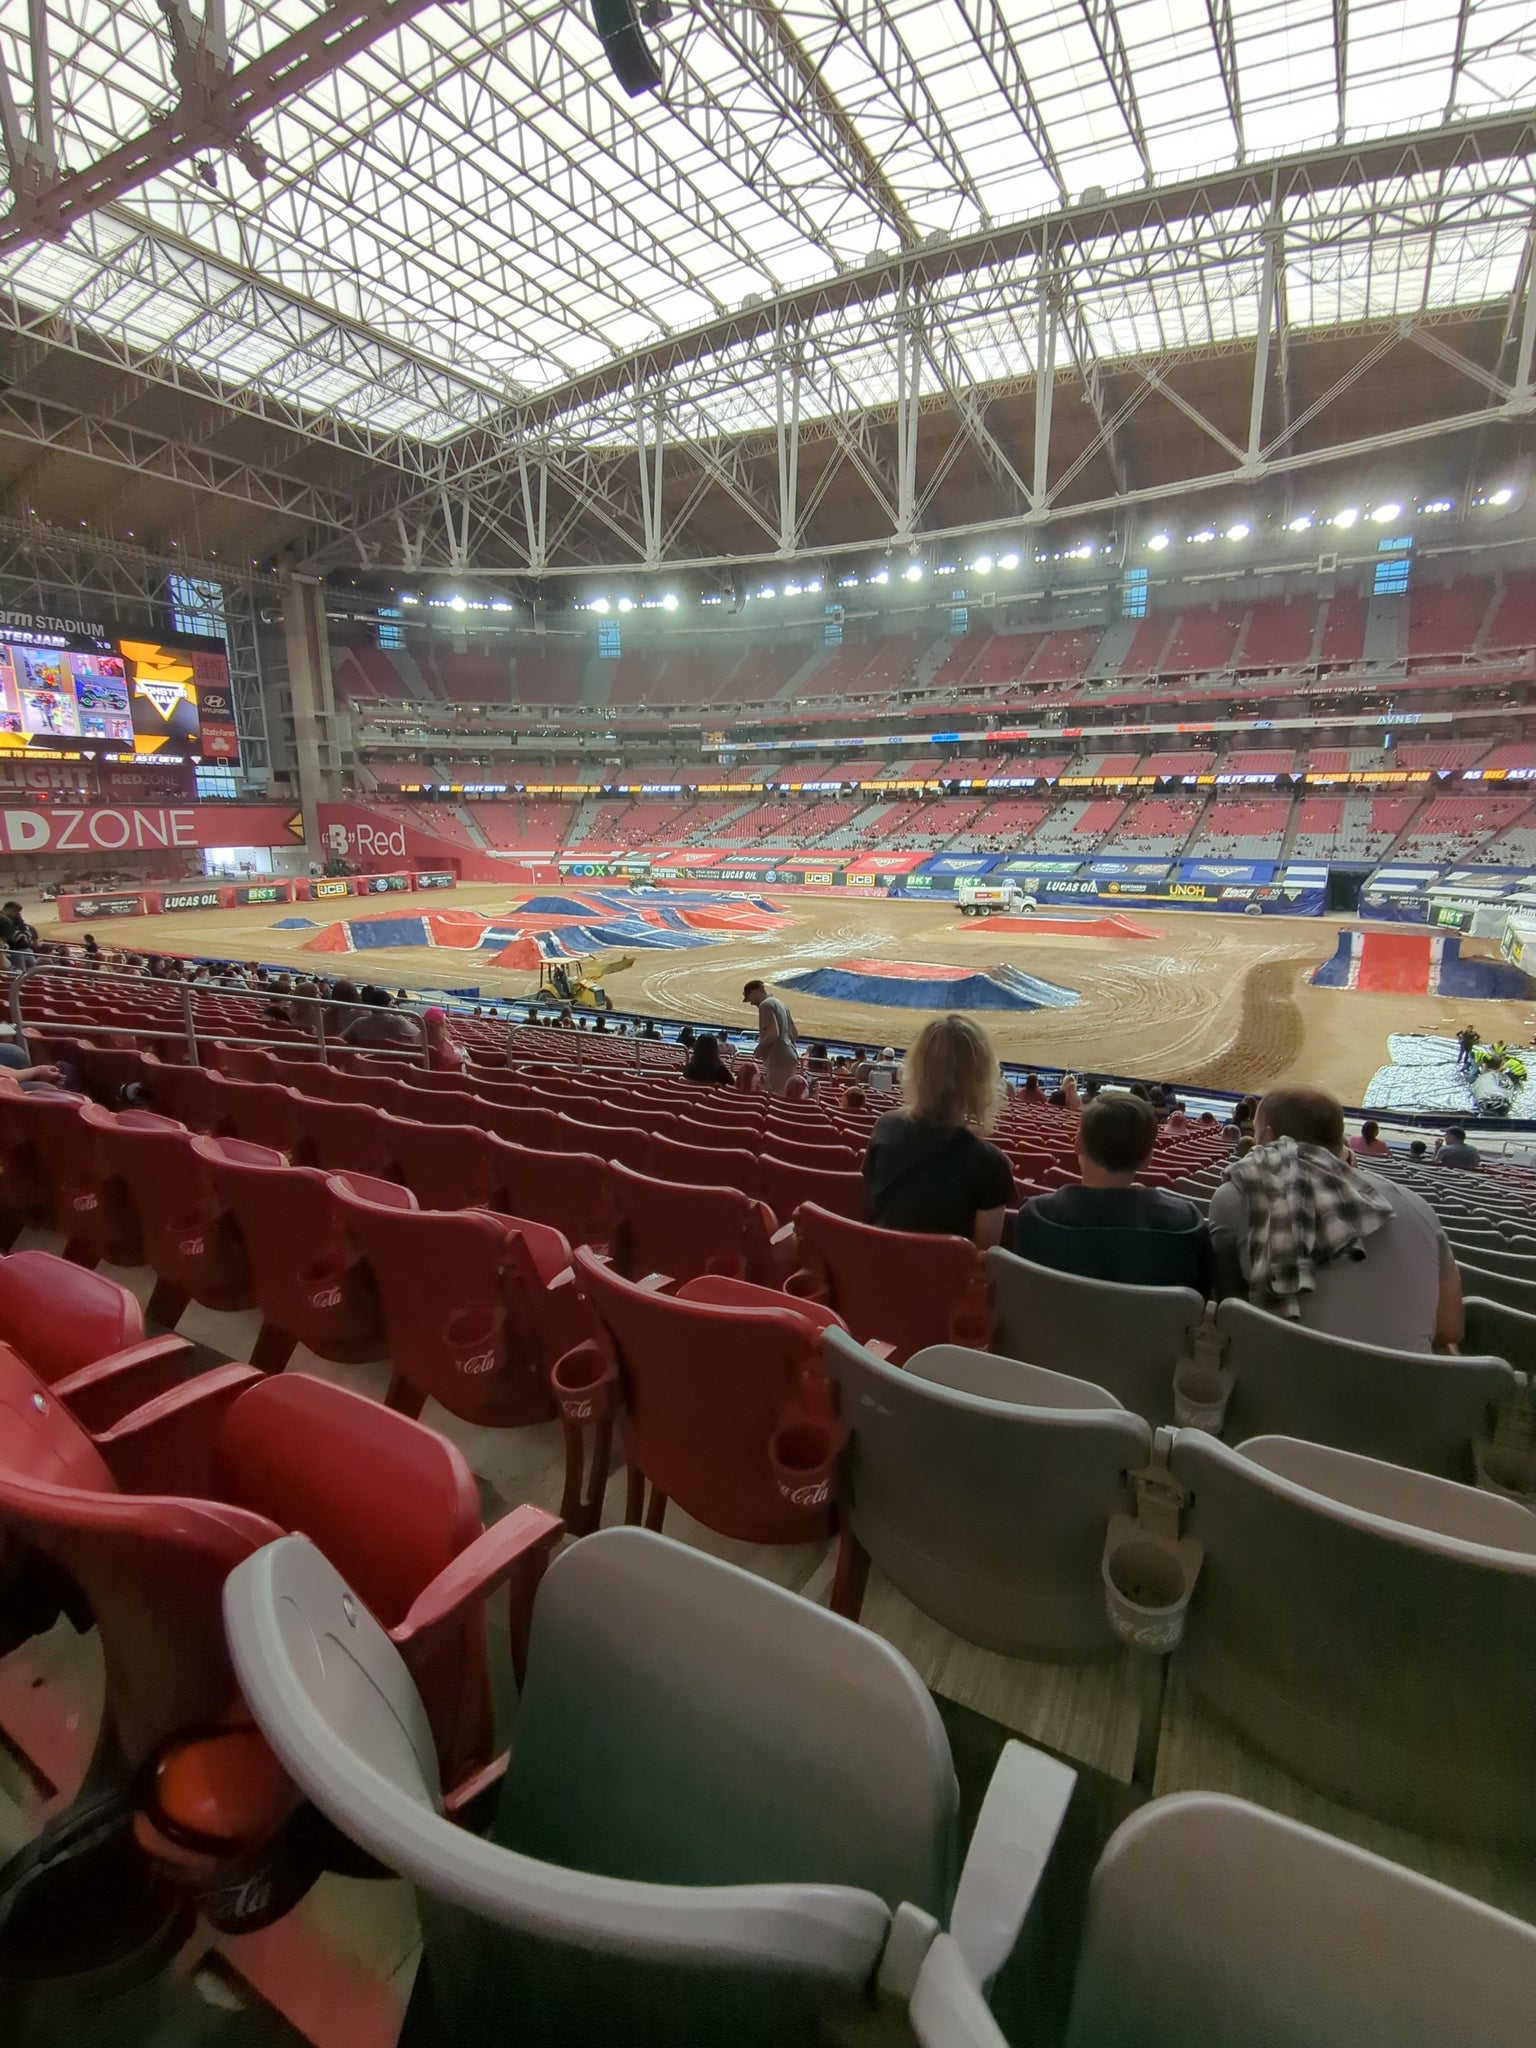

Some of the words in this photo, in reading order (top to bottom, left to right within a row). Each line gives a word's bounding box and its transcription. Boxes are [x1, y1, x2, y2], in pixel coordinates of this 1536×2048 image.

[36, 615, 105, 637] STADIUM
[202, 707, 230, 715] HYUNDAI
[1376, 714, 1423, 724] AVNET
[25, 751, 62, 759] MONSTER
[0, 766, 91, 788] LIGHT
[111, 774, 178, 785] REDZONE
[1181, 776, 1196, 784] AS
[1197, 776, 1215, 784] BIG
[1216, 775, 1231, 783] AS
[1231, 775, 1244, 783] IT
[1245, 775, 1276, 783] GETS!
[1306, 773, 1349, 783] WELCOME
[1350, 773, 1362, 782] TO
[1363, 773, 1407, 782] MONSTER
[1408, 772, 1431, 781] JAM
[1463, 770, 1483, 780] AS
[1483, 770, 1506, 780] BIG
[1506, 770, 1527, 779] AS
[925, 780, 939, 788] JAM
[1010, 779, 1035, 787] GETS!
[1058, 778, 1092, 786] WELCOME
[1104, 777, 1137, 785] MONSTER
[1139, 777, 1156, 785] JAM
[0, 809, 199, 850] DZONE
[356, 824, 406, 856] Red
[573, 864, 605, 876] COX
[721, 871, 744, 879] LUCAS
[744, 872, 757, 880] OIL
[807, 874, 830, 882] JCB
[850, 876, 873, 885] JCB
[906, 875, 932, 886] BKT
[955, 876, 981, 887] BKT
[320, 884, 345, 895] JCB
[1046, 881, 1079, 892] LUCAS
[1169, 884, 1206, 895] UNOH
[249, 888, 276, 900] BKT
[165, 896, 199, 908] LUCAS
[201, 894, 218, 905] OIL
[1438, 909, 1463, 923] BKT
[309, 1286, 343, 1308] Cola
[463, 1350, 495, 1376] Cola
[562, 1398, 592, 1419] Cola
[790, 1479, 829, 1506] Cola
